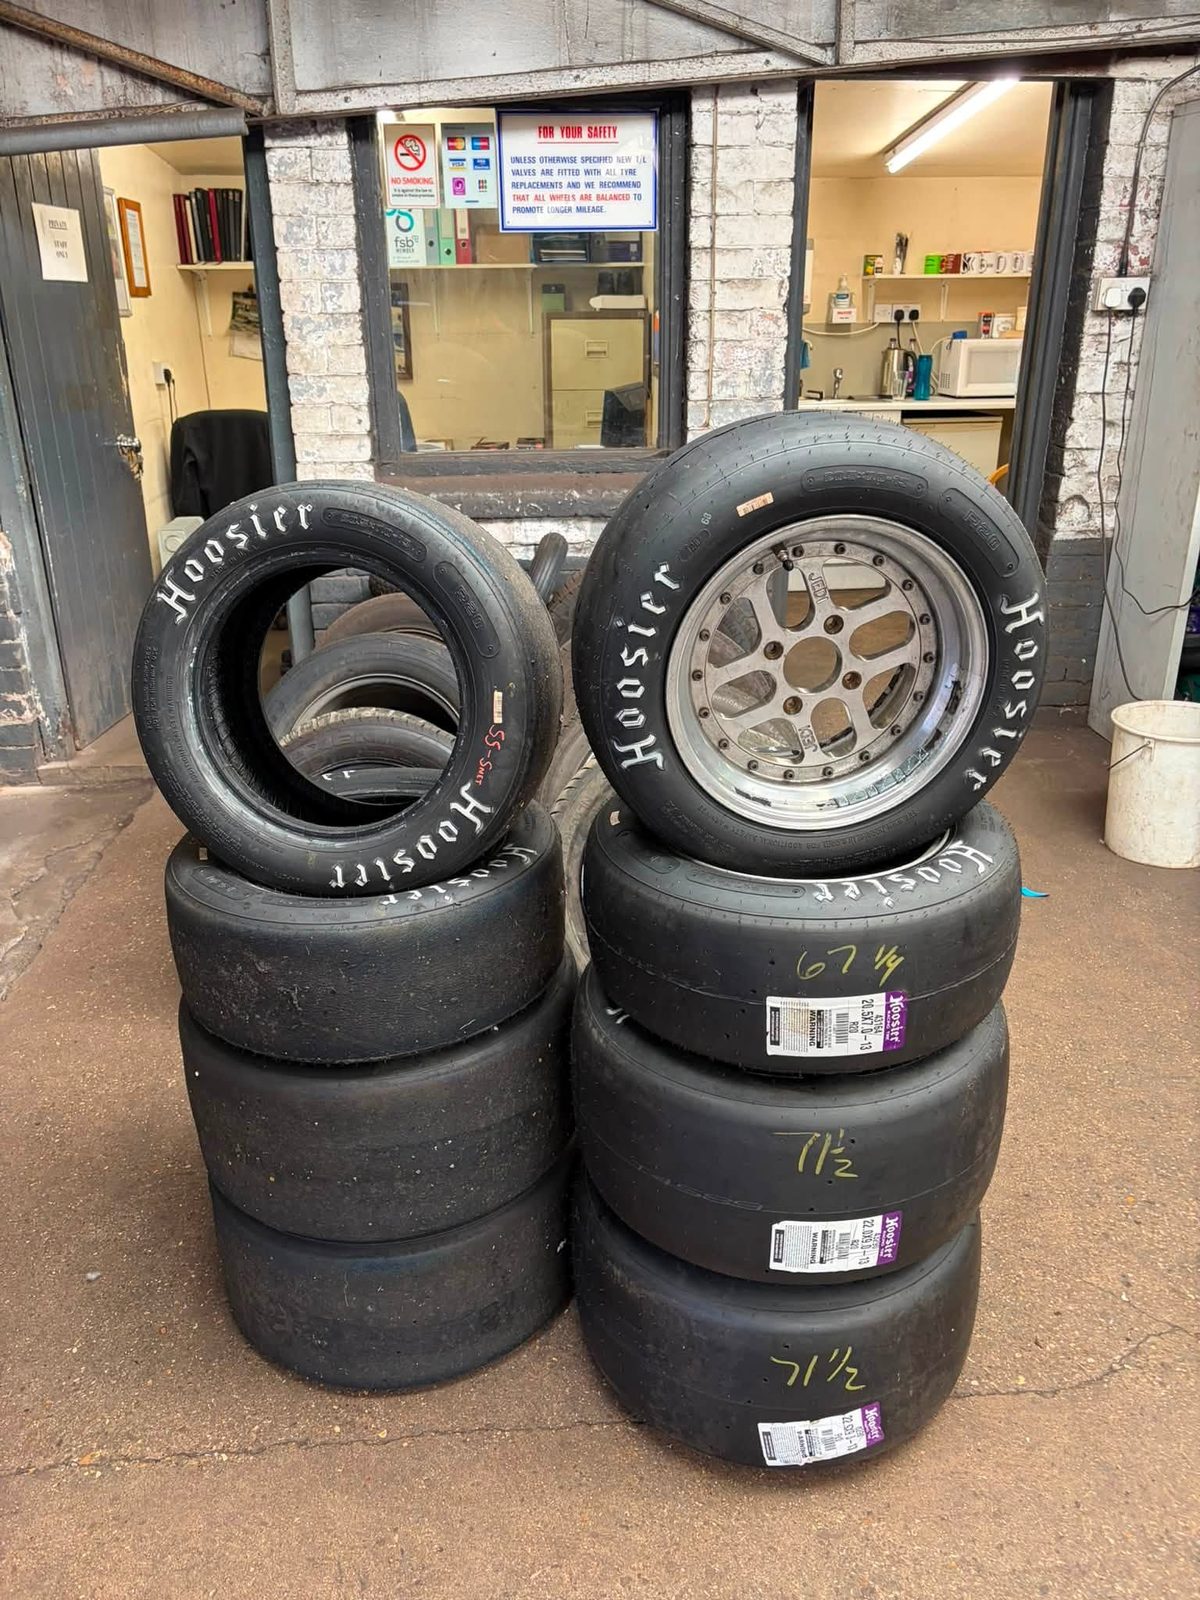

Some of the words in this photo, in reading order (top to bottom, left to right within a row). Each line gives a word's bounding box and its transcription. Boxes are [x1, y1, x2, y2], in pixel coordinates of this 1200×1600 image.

[538, 126, 554, 138] FOR
[560, 126, 582, 138] YOUR
[588, 126, 617, 138] SAFETY
[511, 156, 536, 164] UNLESS
[539, 156, 577, 164] OTHERWISE
[580, 156, 613, 164] SPECIFIED
[511, 168, 536, 176] VALVES
[541, 168, 554, 176] ARE
[558, 168, 580, 176] FITTED
[584, 168, 601, 176] WITH
[391, 176, 401, 185] NO
[402, 176, 434, 185] SMOKING
[511, 181, 563, 190] REPLACEMENTS
[567, 181, 581, 189] AND
[584, 181, 595, 189] WE
[599, 181, 641, 189] RECOMMEND
[512, 193, 529, 202] THAT
[534, 193, 546, 202] ALL
[549, 193, 576, 202] WHEELS
[580, 193, 592, 201] ARE
[596, 193, 631, 201] BALANCED
[633, 193, 642, 201] TO
[512, 206, 544, 214] PROMOTE
[547, 206, 572, 214] LONGER
[394, 236, 414, 248] fsb
[157, 503, 313, 625] Hoosier
[809, 572, 829, 604] JEDI
[612, 562, 680, 771] Hoosier
[965, 592, 1044, 791] Hoosier
[329, 782, 494, 888] Hoosier
[811, 839, 994, 907] Hoosier
[796, 944, 857, 980] 67
[808, 1009, 816, 1046] WARNING
[849, 1021, 859, 1034] R20
[889, 995, 905, 1042] Hoosier
[810, 1232, 818, 1264] WARNING
[885, 1217, 899, 1258] Hoosier
